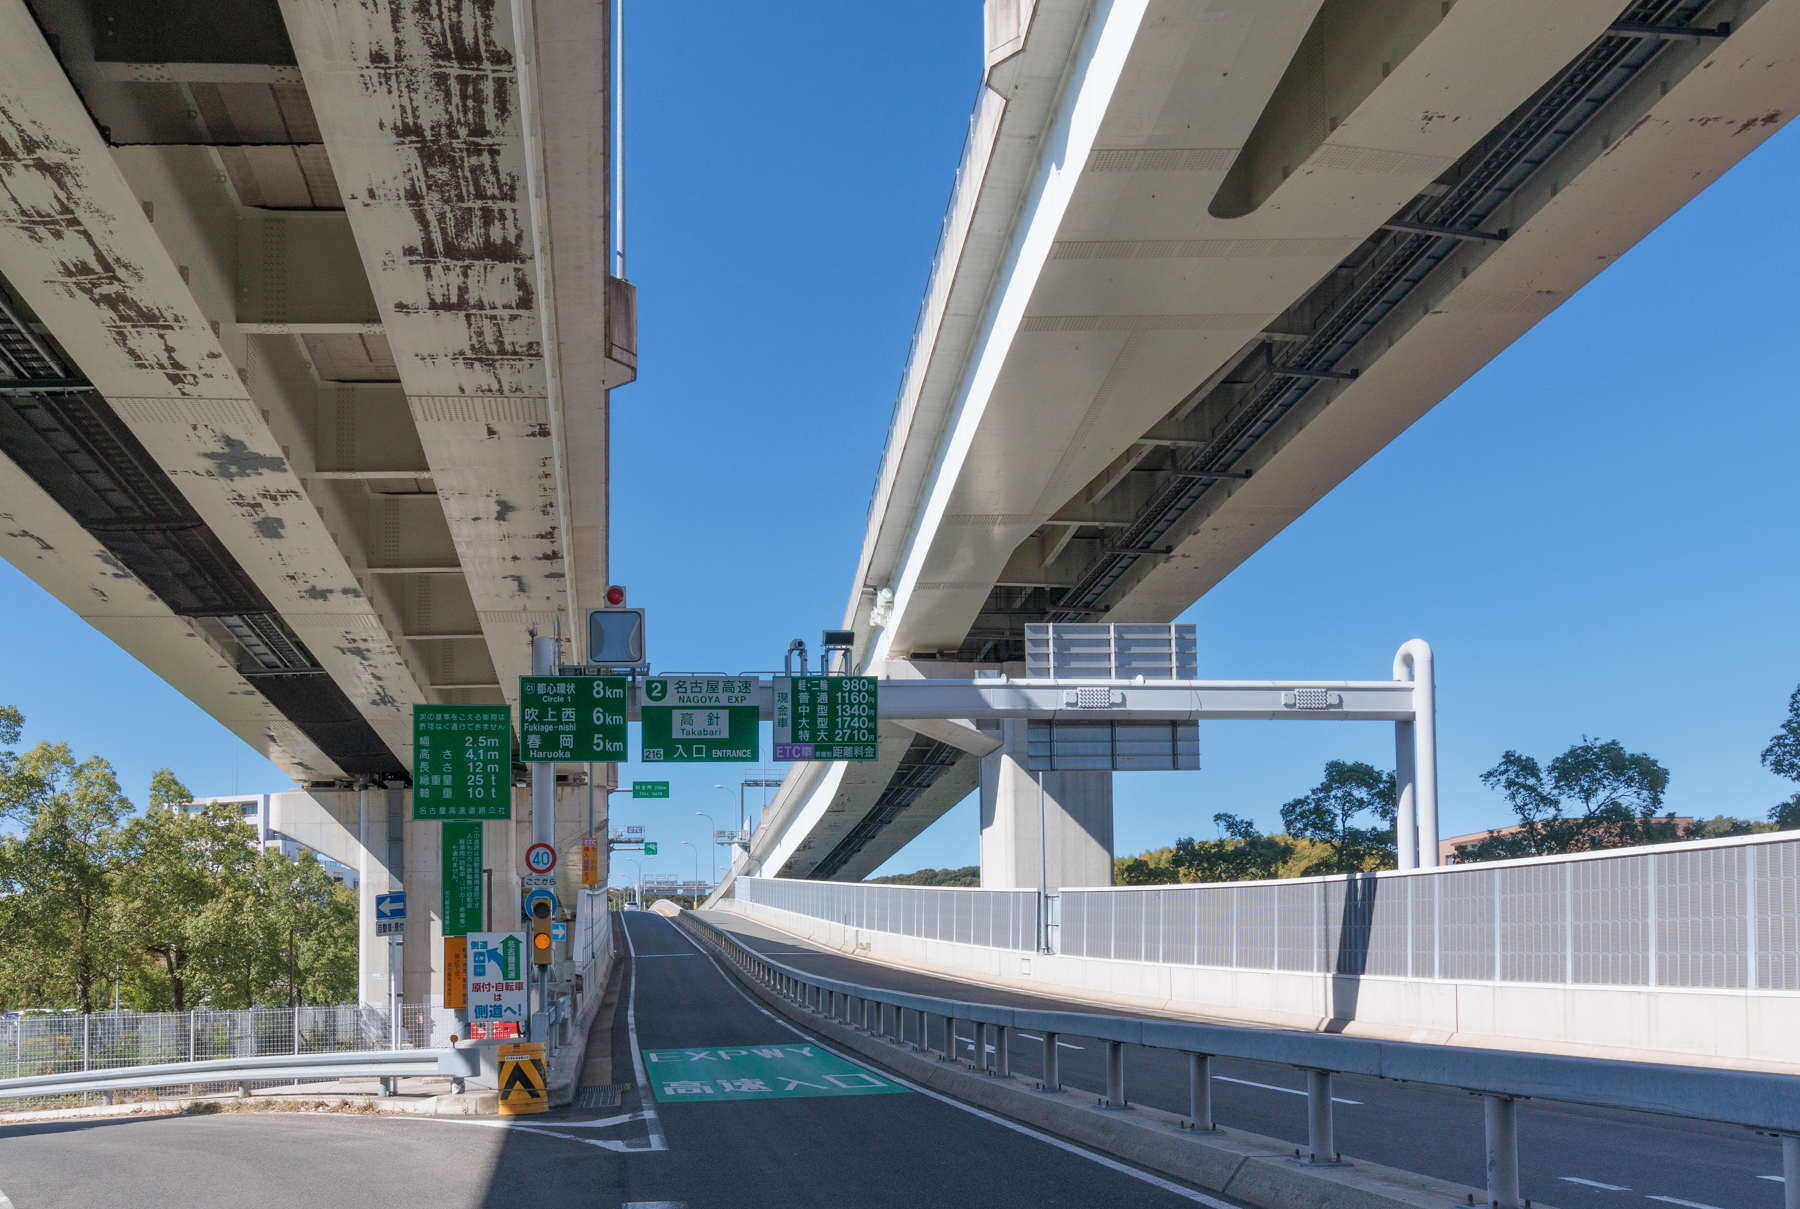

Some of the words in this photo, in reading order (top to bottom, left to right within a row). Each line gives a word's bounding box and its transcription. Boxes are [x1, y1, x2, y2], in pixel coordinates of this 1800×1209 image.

[537, 683, 575, 694] 都心環状
[651, 682, 662, 696] 2
[674, 680, 752, 694] 名古屋高速
[798, 692, 828, 703] 普通
[524, 708, 575, 722] 吹上西
[777, 692, 788, 728] 現金車
[798, 705, 828, 716] 中型
[681, 712, 720, 726] 高針
[798, 718, 828, 728] 大型
[524, 723, 576, 732] Fukiage-nishi
[798, 730, 828, 741] 特大
[419, 736, 429, 746] 幅
[465, 736, 498, 747] 2.5m
[527, 734, 573, 749] 春岡
[645, 750, 662, 758] 216
[674, 745, 706, 758] 入口
[533, 852, 550, 865] 40
[471, 941, 488, 949] 側道
[472, 982, 524, 992] 原付・自転車
[494, 994, 502, 1002] は
[650, 1046, 814, 1063] EXPWY
[663, 1074, 888, 1095] 高速入口
